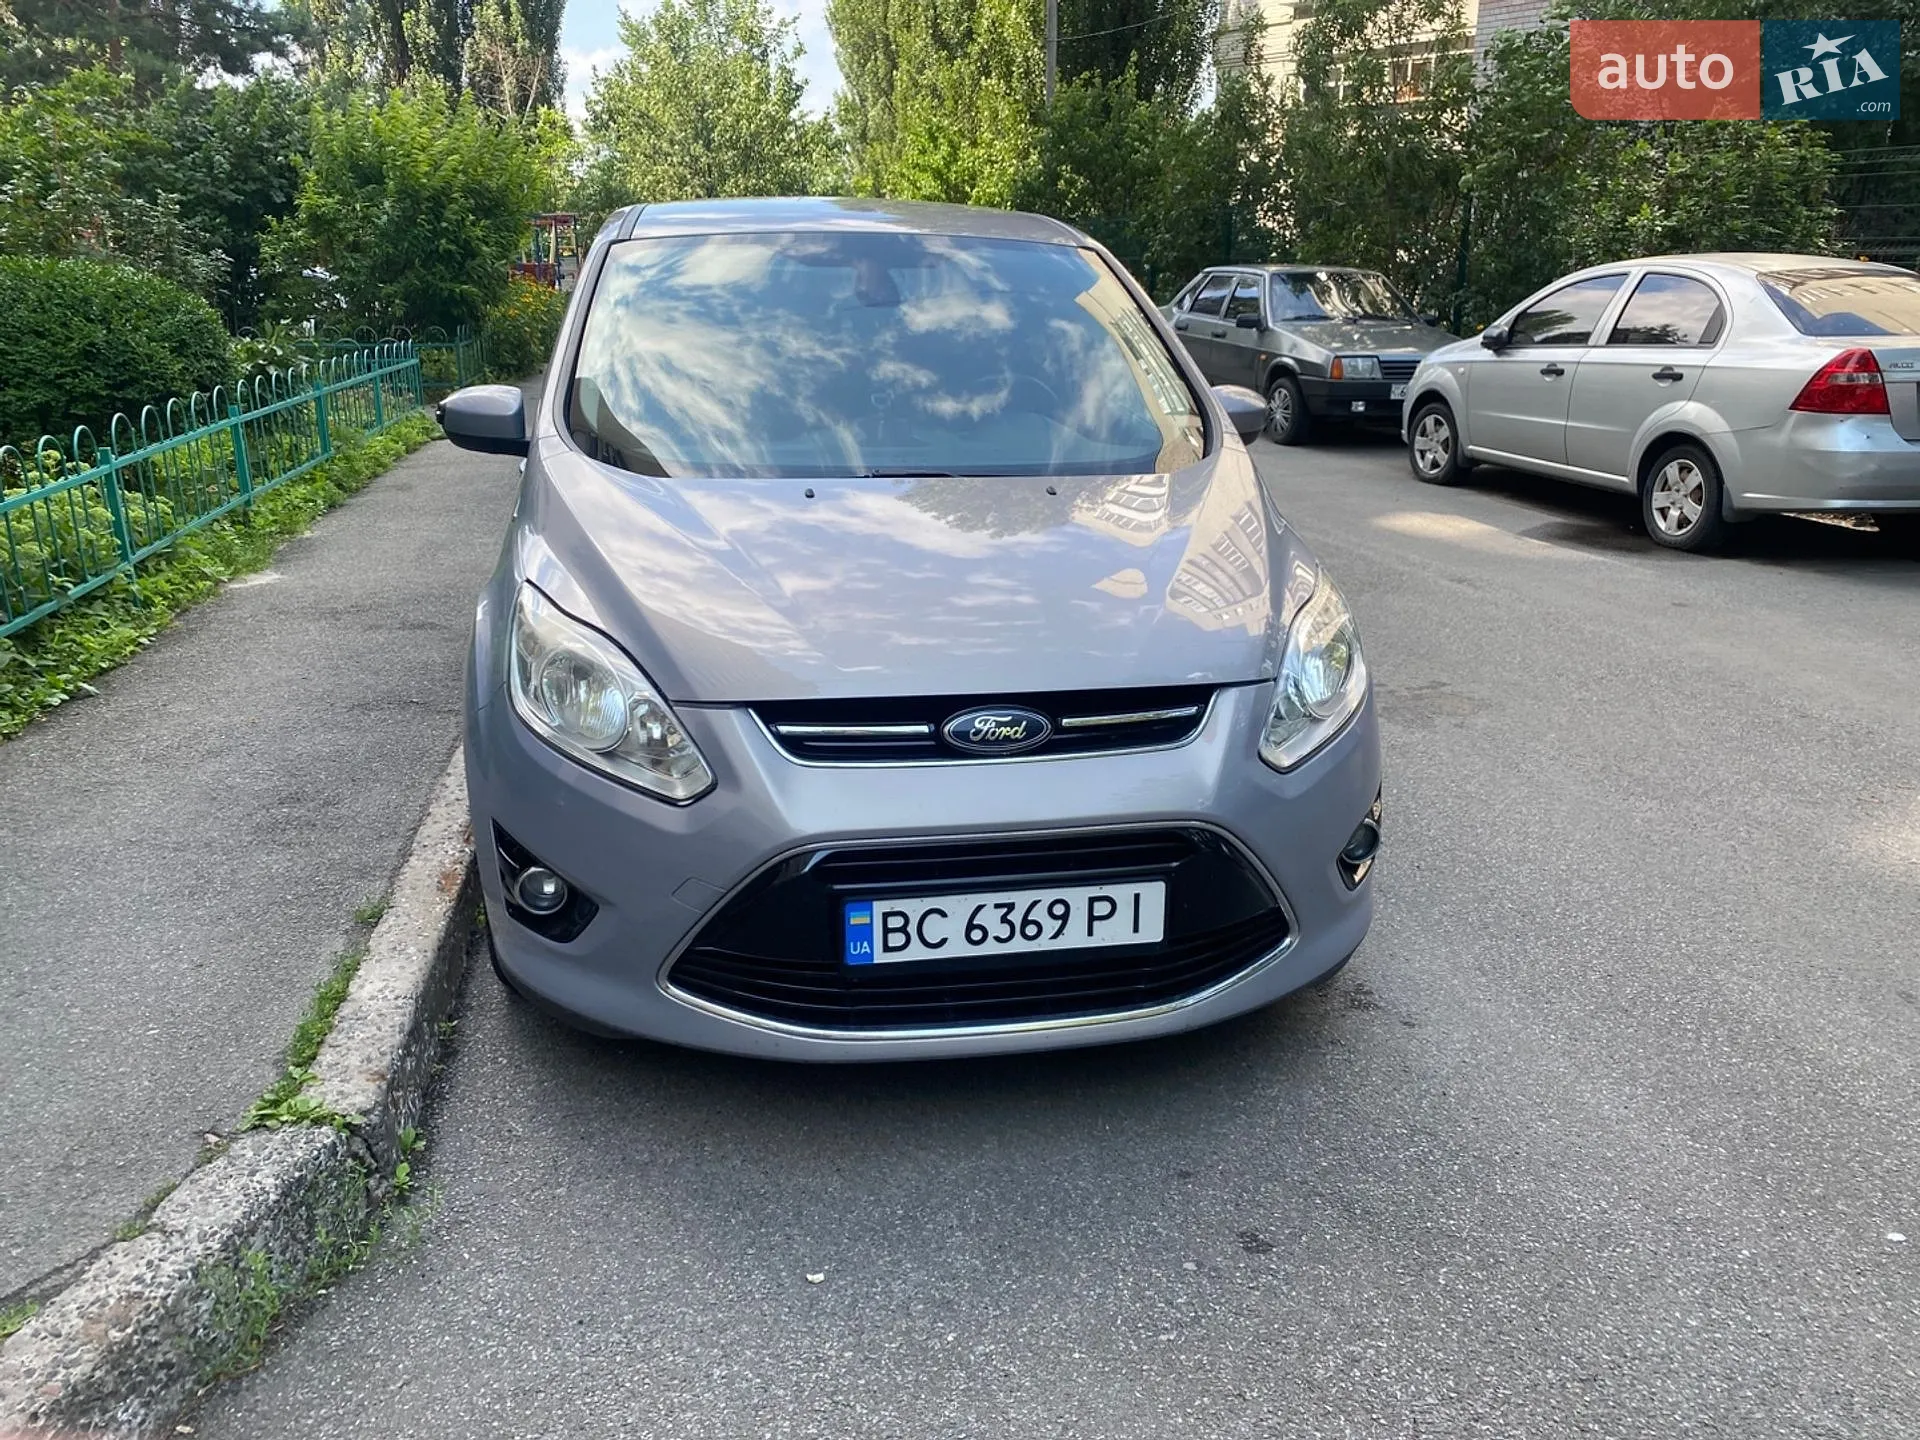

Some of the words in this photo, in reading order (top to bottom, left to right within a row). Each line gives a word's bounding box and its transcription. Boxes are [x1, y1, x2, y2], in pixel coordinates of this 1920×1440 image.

[969, 716, 1027, 741] Ford
[882, 907, 949, 953] BC
[964, 898, 1071, 947] 6369
[1087, 893, 1141, 937] PI
[850, 941, 871, 955] UA
